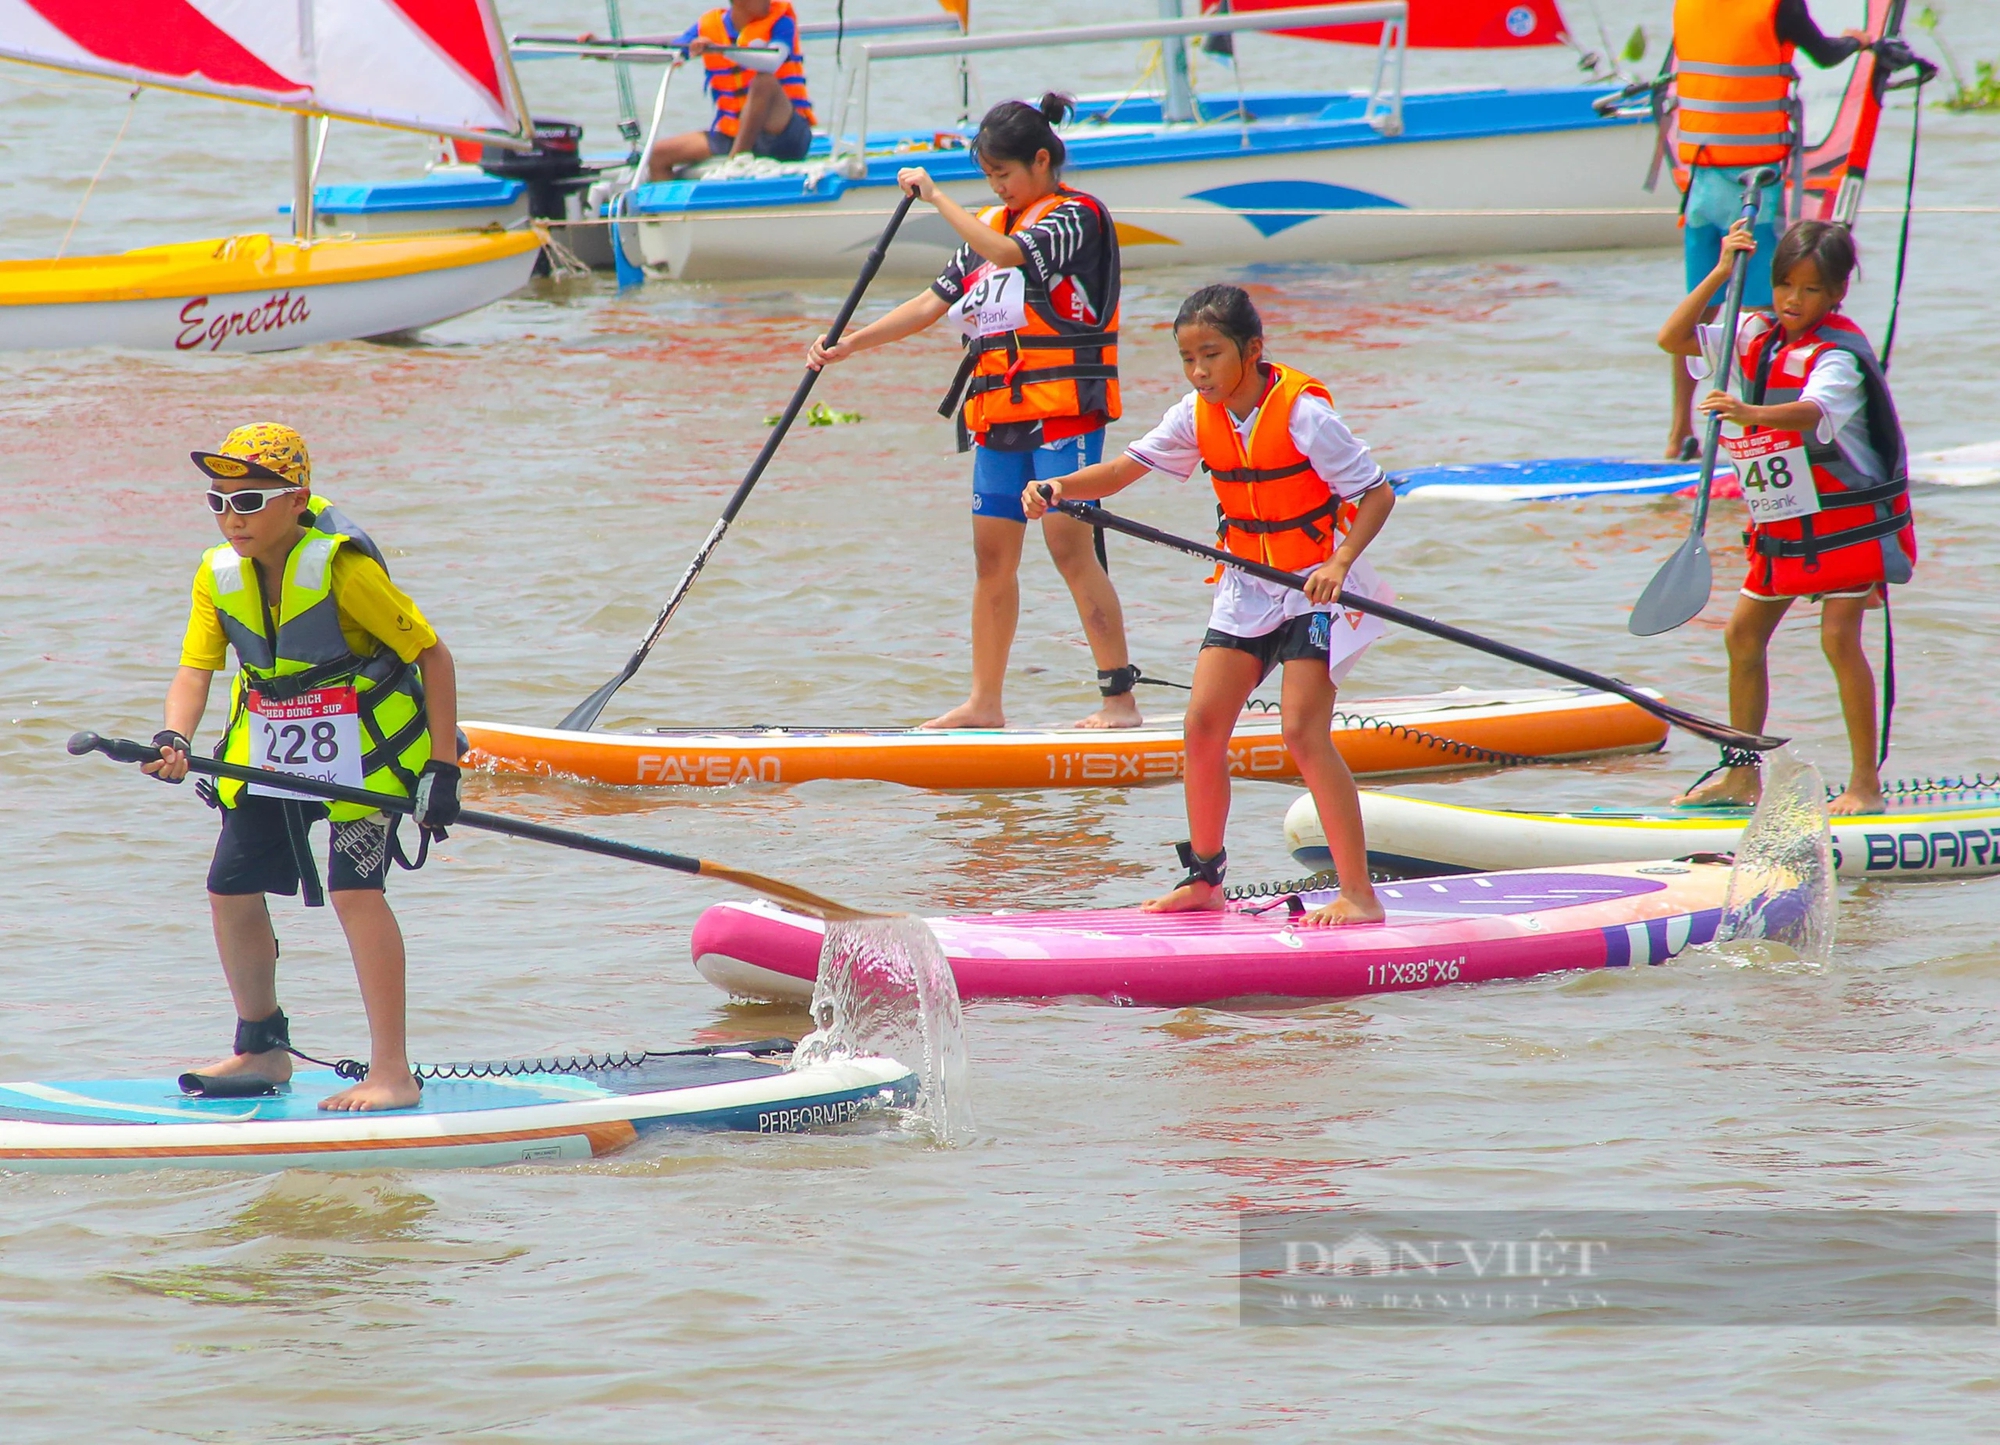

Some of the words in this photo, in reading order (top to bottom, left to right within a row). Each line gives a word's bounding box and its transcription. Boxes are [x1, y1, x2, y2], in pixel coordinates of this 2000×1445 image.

[936, 275, 958, 295] LER
[175, 288, 311, 351] Egretta
[1733, 456, 1794, 493] 48
[1747, 494, 1797, 512] PBank
[323, 704, 342, 714] SUP
[263, 721, 339, 765] 228
[636, 754, 781, 783] FAYEAN
